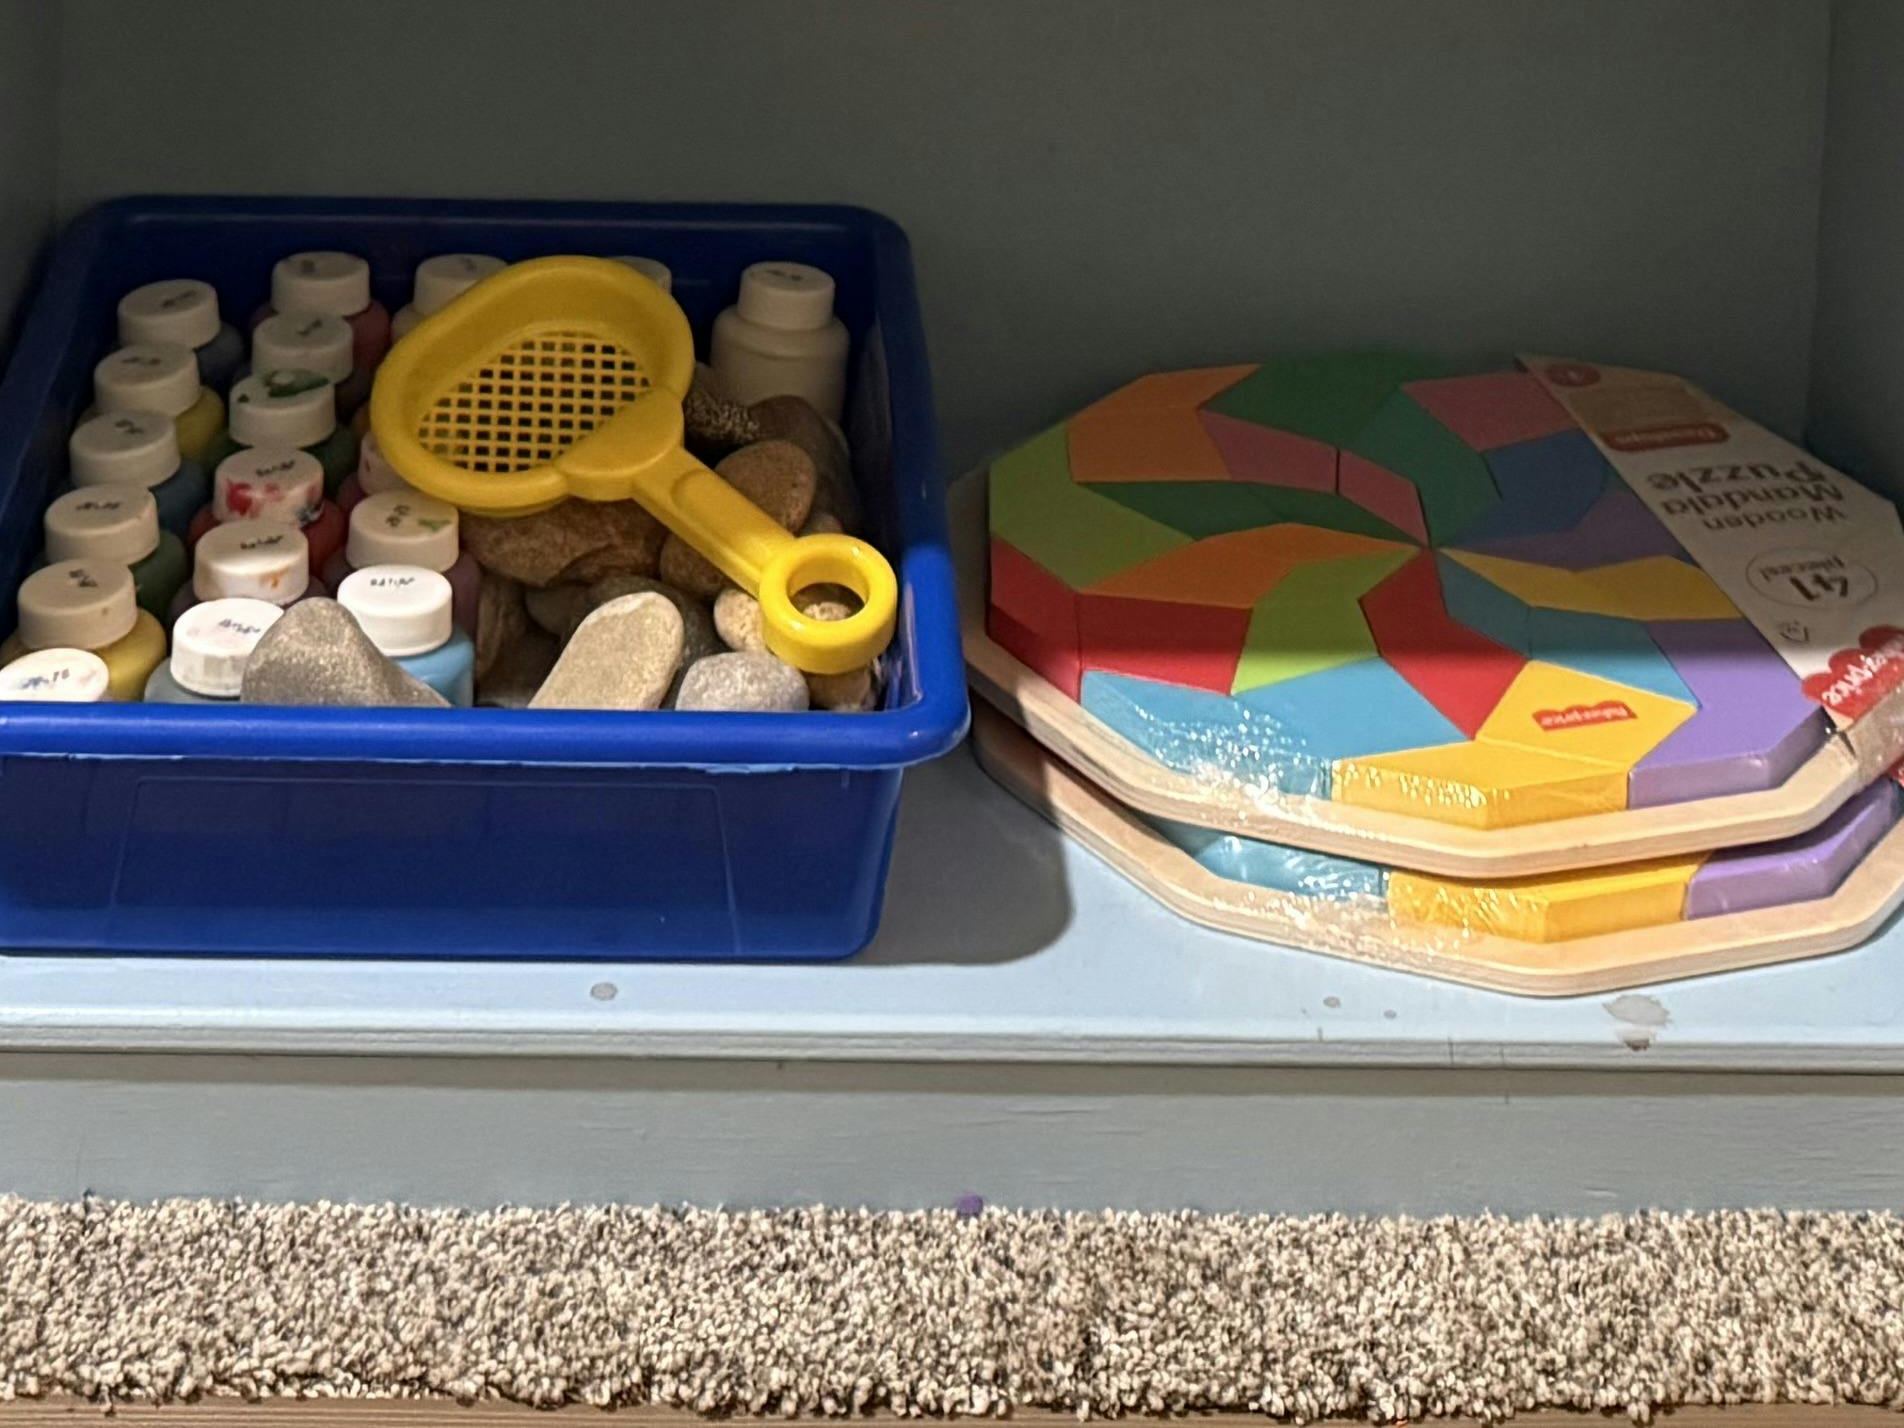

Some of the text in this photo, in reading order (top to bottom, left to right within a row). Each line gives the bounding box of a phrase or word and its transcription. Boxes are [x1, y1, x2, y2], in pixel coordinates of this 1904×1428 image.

[1646, 460, 1827, 494] Puzzle
[1661, 484, 1844, 517] Mandala
[1702, 505, 1848, 532] Wooden
[1789, 574, 1850, 602] 41
